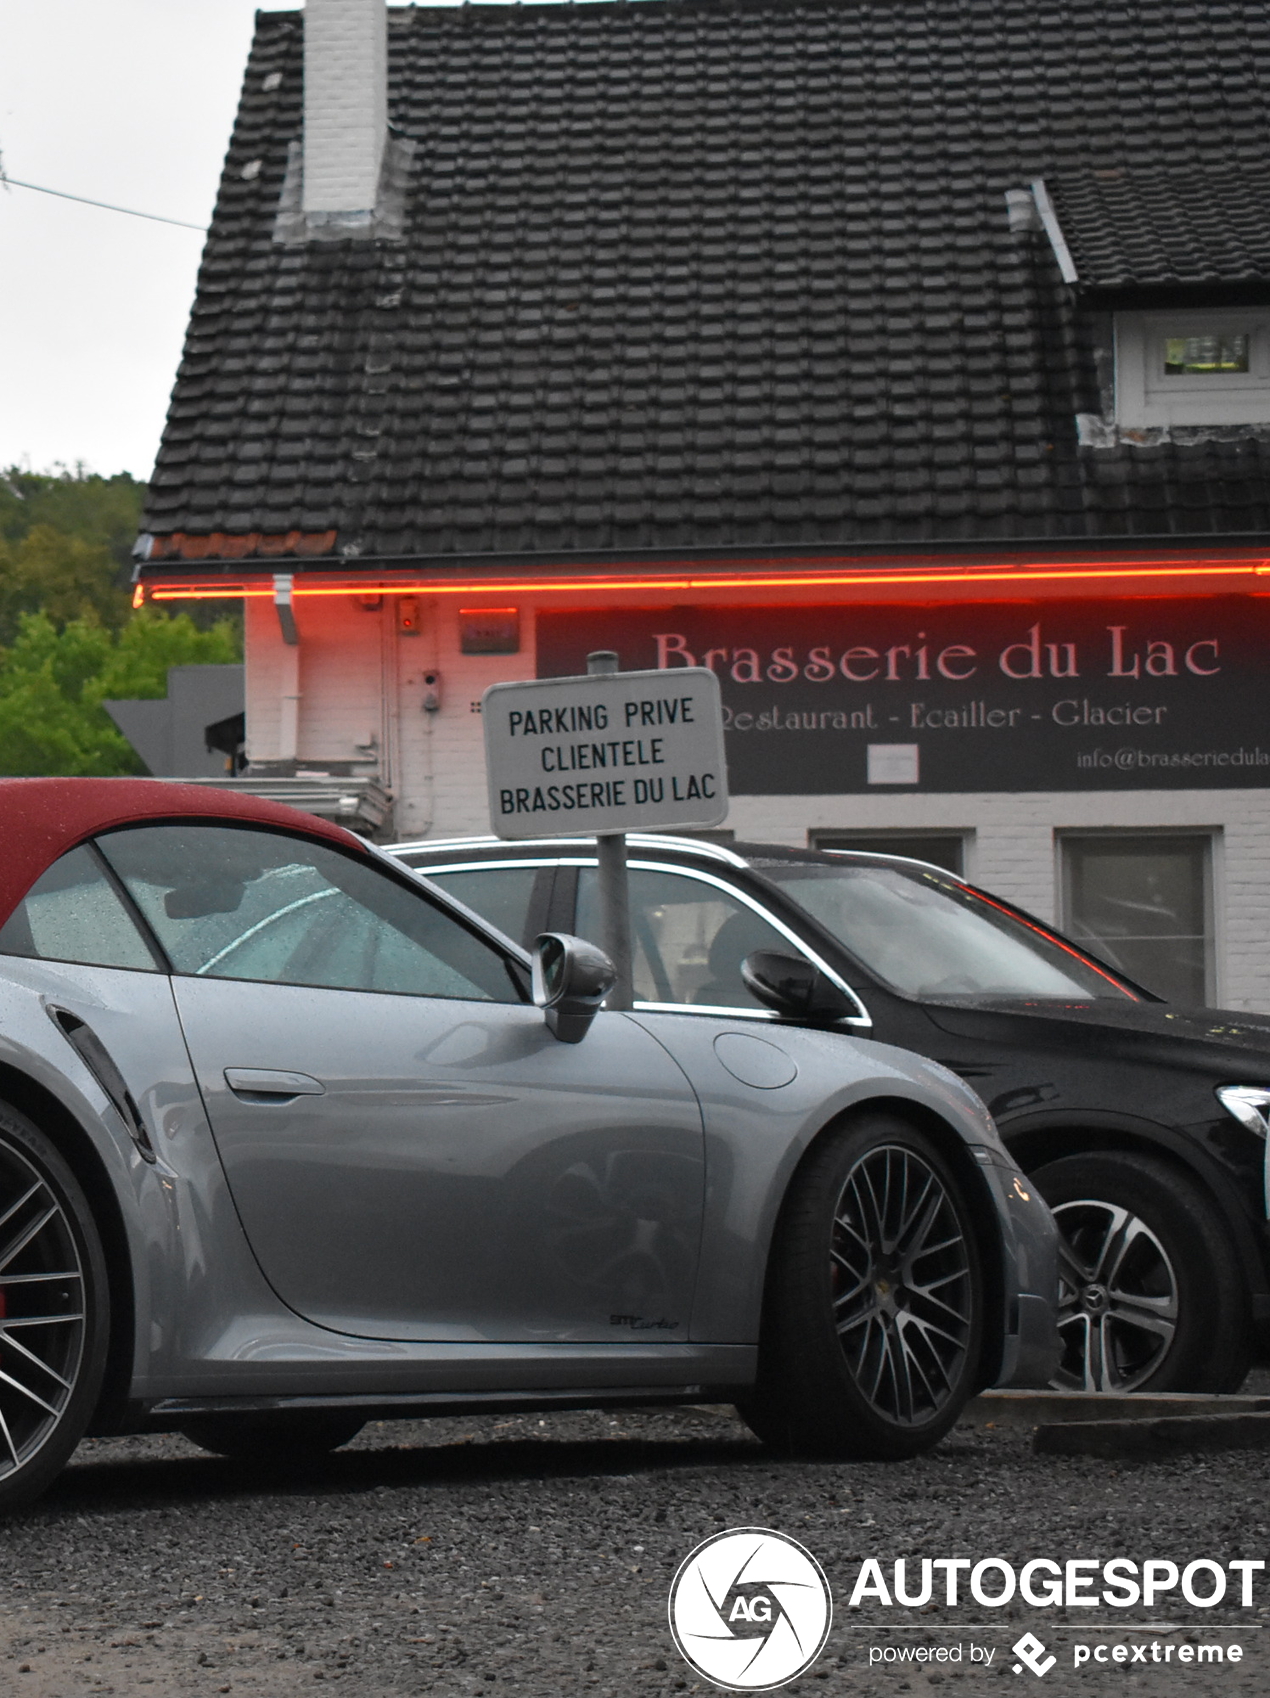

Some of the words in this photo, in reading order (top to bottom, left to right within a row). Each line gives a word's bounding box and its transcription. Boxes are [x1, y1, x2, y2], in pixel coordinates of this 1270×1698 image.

[652, 631, 977, 683] Brasserie
[999, 622, 1079, 679] du
[1106, 625, 1221, 680] Lac
[509, 704, 608, 737] PARKING
[625, 697, 694, 728] PRIVE
[1052, 699, 1167, 727] Glacier
[541, 738, 664, 773] CLIENTELE
[1077, 747, 1270, 770] info@brasseriedula
[500, 780, 627, 814] BRASSERIE
[634, 777, 664, 804] DU
[672, 773, 716, 802] LAC
